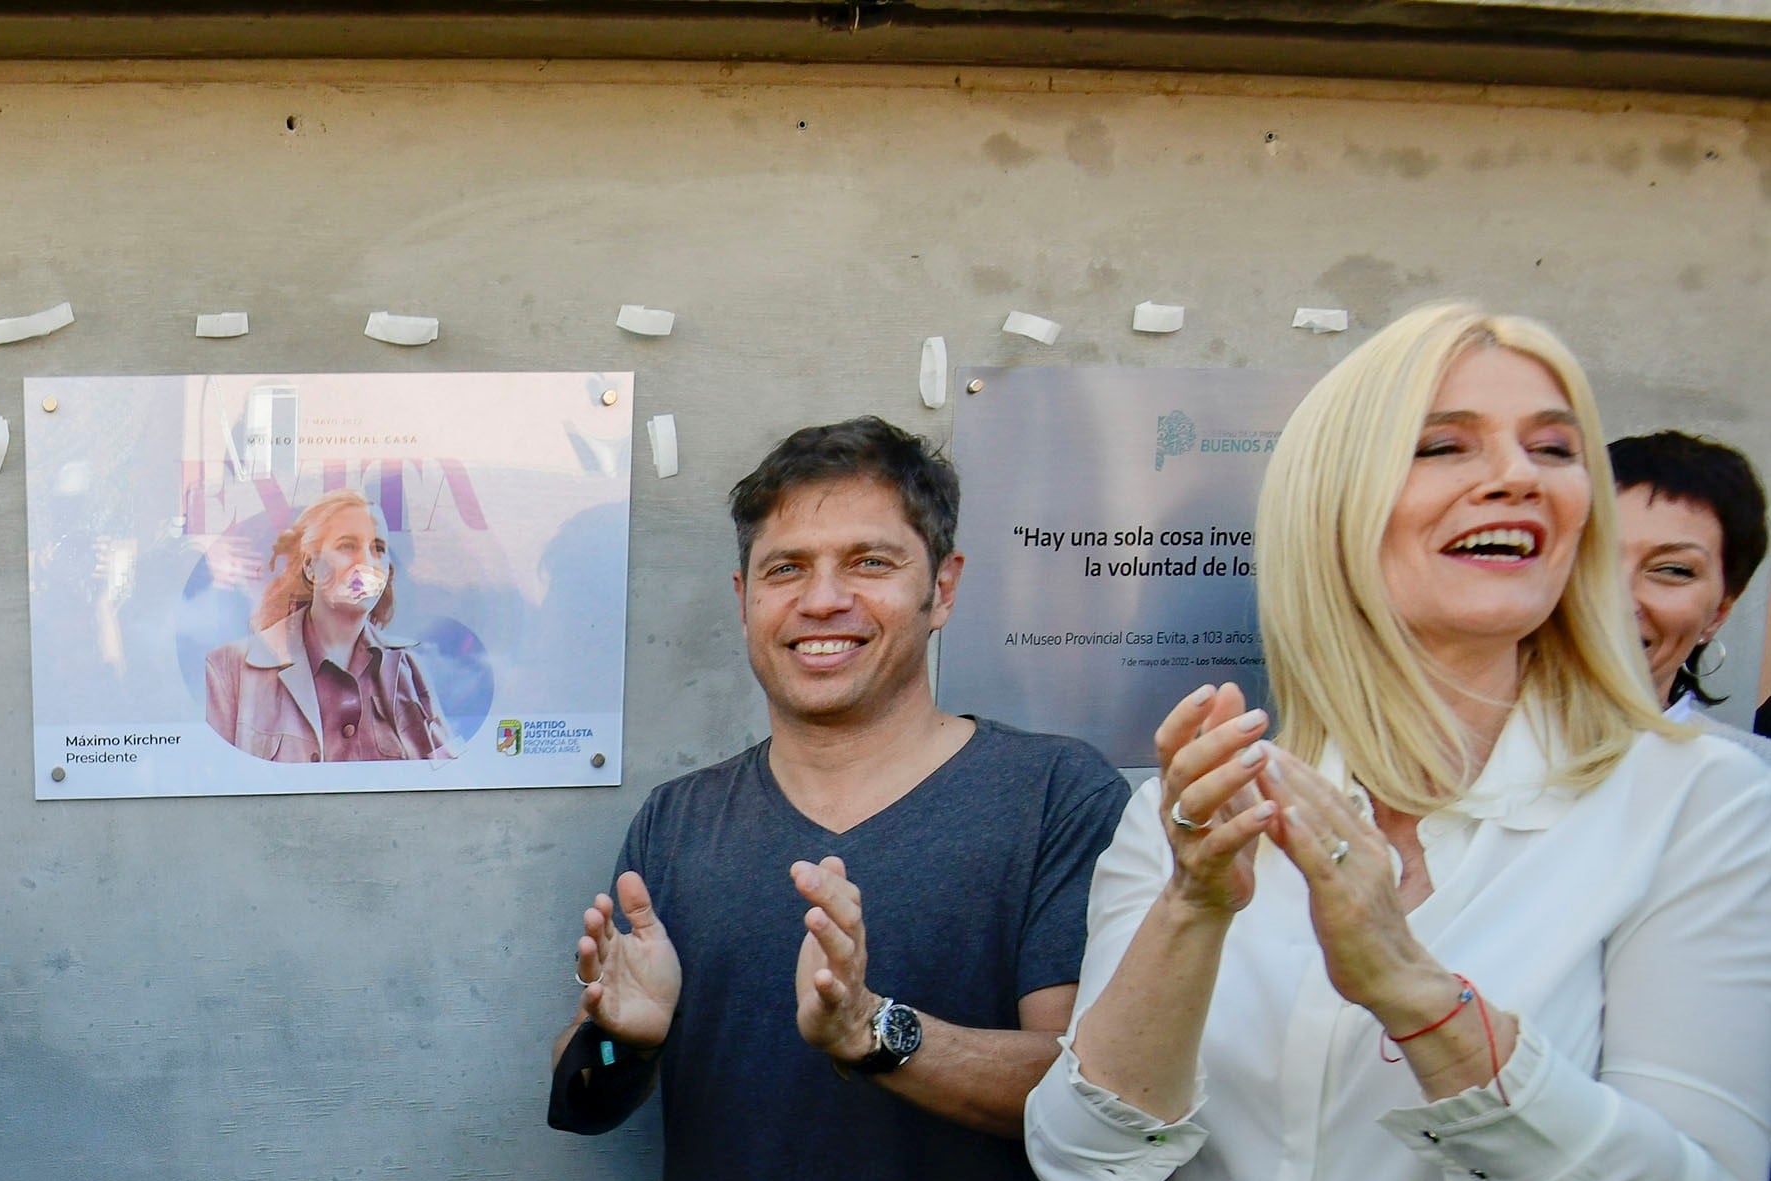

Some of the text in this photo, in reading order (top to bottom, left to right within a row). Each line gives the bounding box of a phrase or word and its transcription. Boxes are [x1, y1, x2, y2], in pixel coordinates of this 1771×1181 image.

[298, 435, 379, 445] PROVINCIAL
[384, 434, 418, 445] CASA
[1200, 438, 1261, 453] BUENOS
[1071, 530, 1108, 547] una
[1114, 525, 1154, 546] sola
[1160, 529, 1204, 546] cosa
[1085, 556, 1102, 577] la
[1108, 555, 1198, 577] voluntad
[1203, 556, 1227, 577] de
[1005, 632, 1018, 646] Al
[1021, 632, 1062, 646] Museo
[1065, 631, 1123, 645] Provincial
[1126, 631, 1153, 645] Casa
[1192, 634, 1199, 644] a
[1203, 631, 1222, 644] 103
[1225, 630, 1253, 644] años
[1121, 657, 1126, 666] 7
[1127, 657, 1137, 667] de
[1138, 659, 1159, 669] mayo
[1160, 657, 1169, 666] de
[1171, 656, 1189, 667] 2022
[1196, 657, 1210, 666] Los
[524, 720, 566, 729] PARTIDO
[65, 733, 182, 747] Máximo Kirchner
[524, 728, 594, 739] JUSTICIALISTA
[523, 745, 557, 755] BUENOS
[65, 751, 138, 764] Presidente
